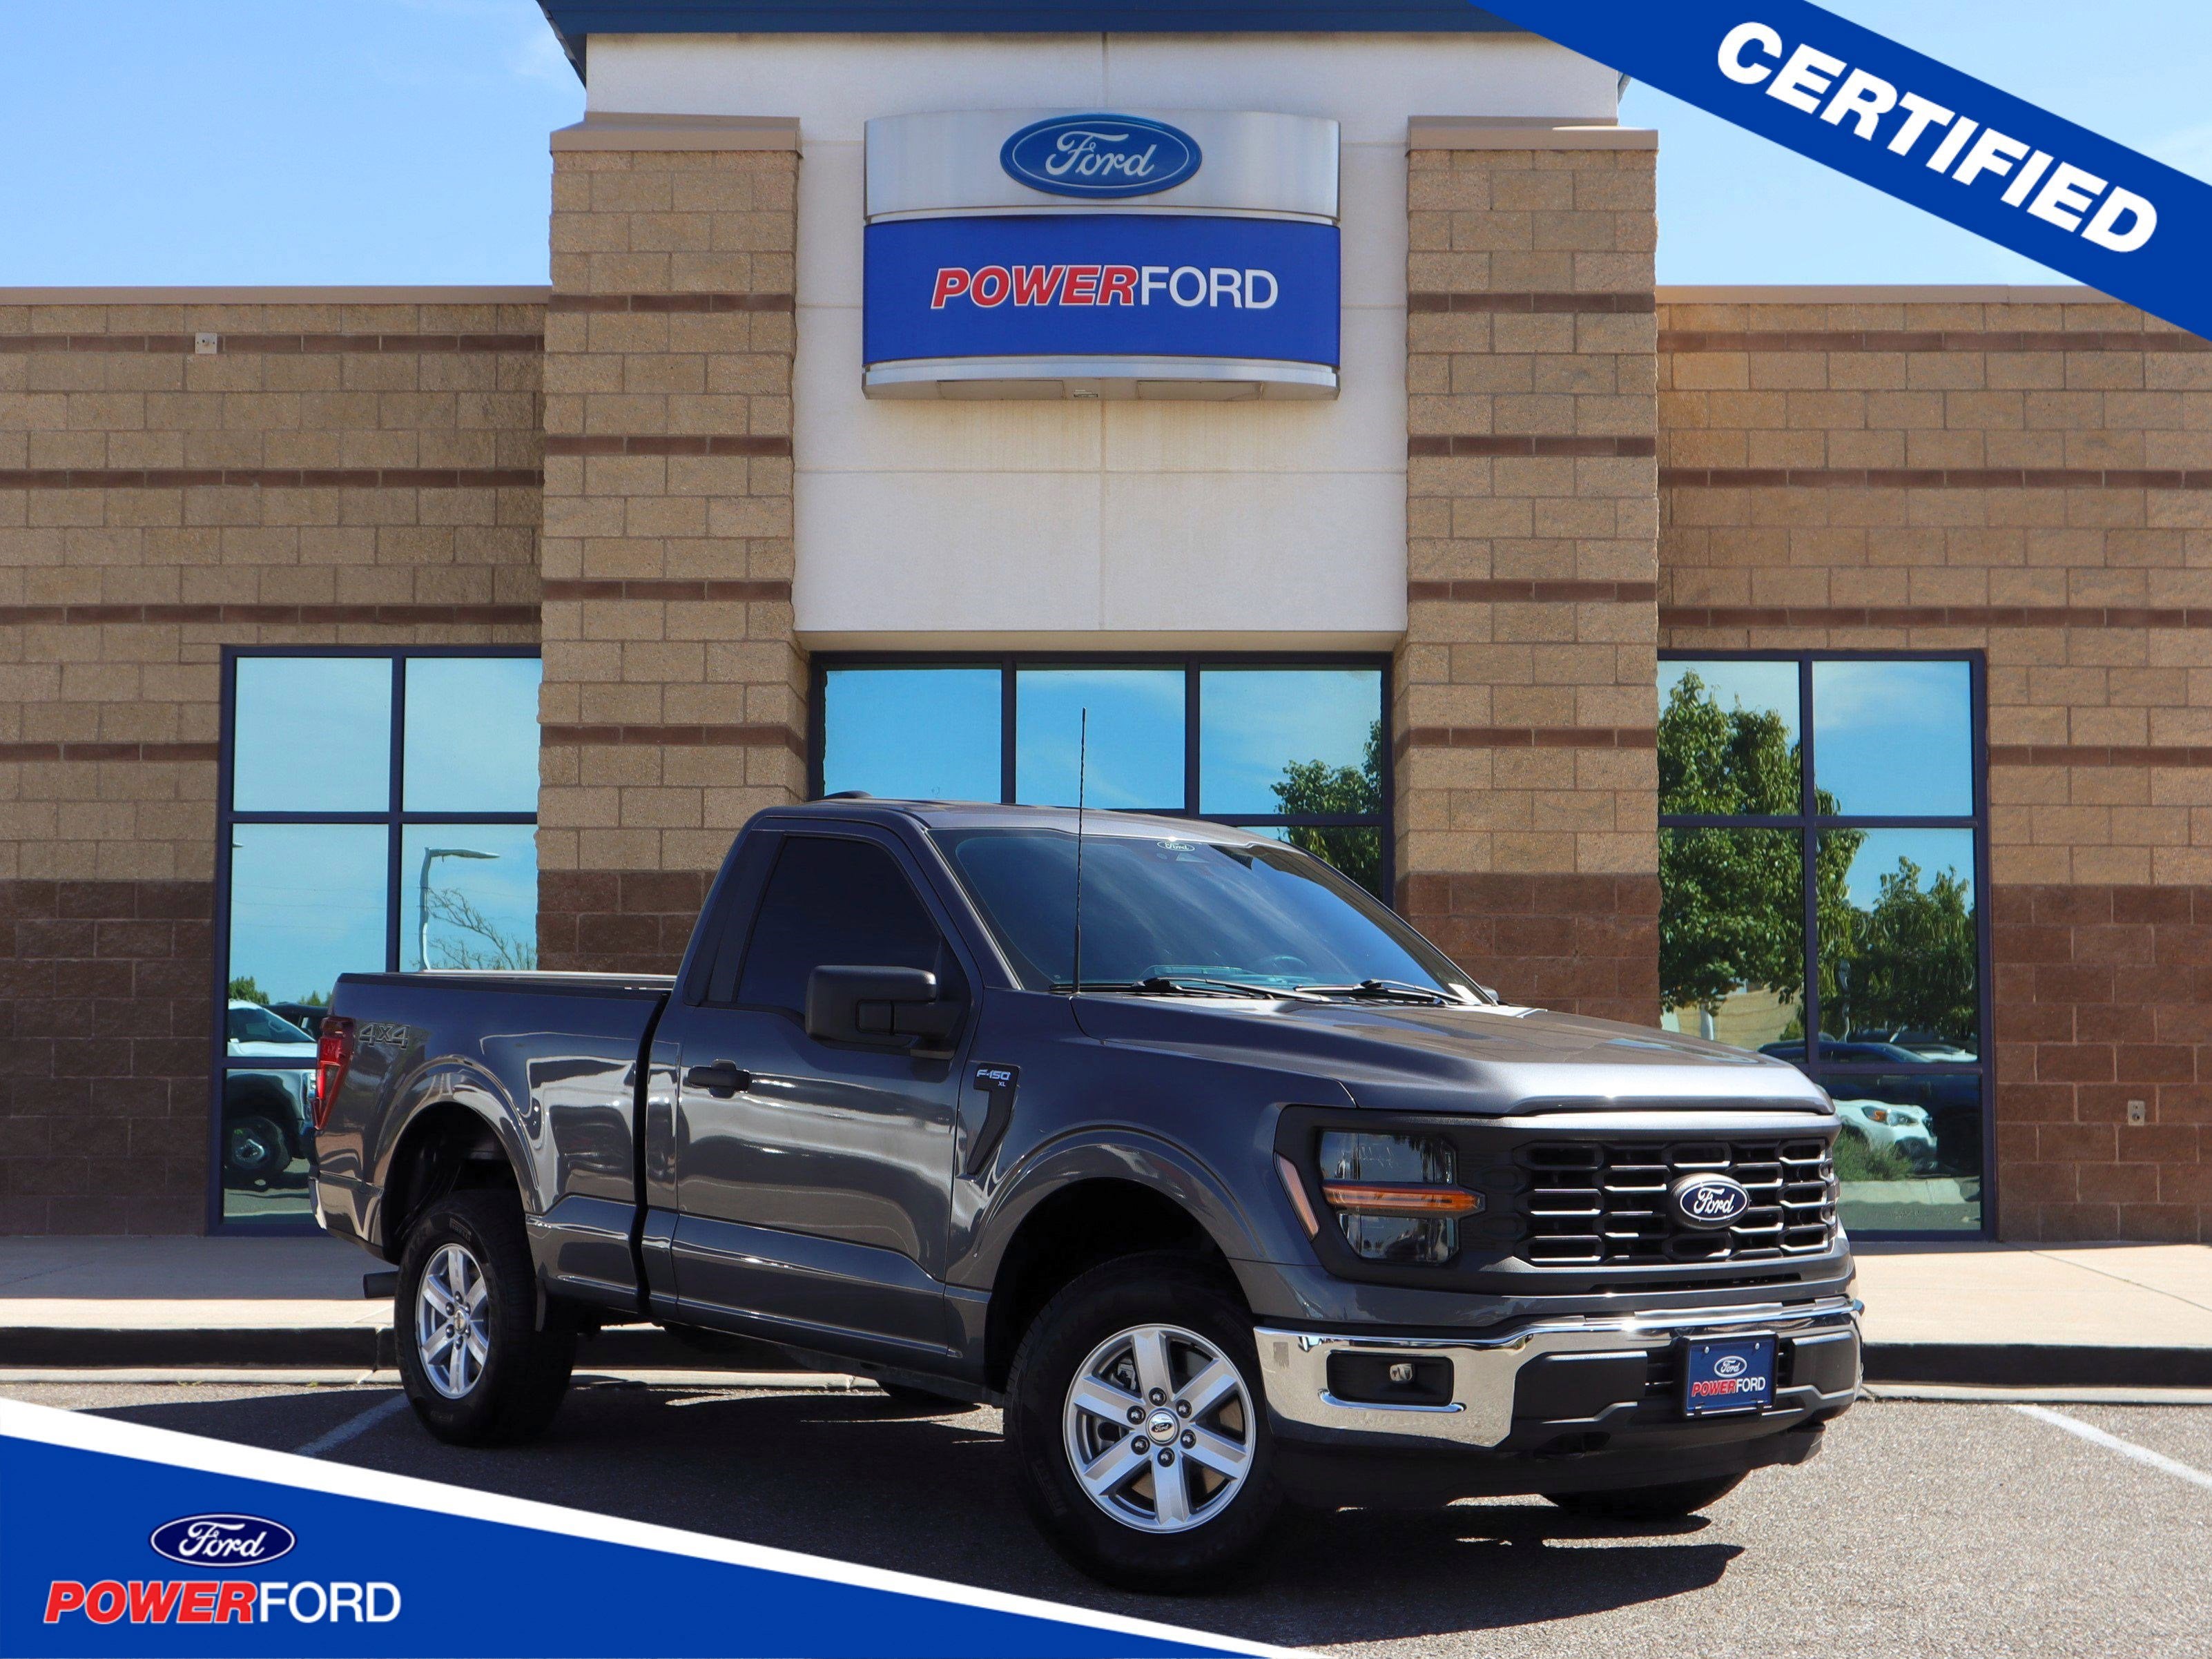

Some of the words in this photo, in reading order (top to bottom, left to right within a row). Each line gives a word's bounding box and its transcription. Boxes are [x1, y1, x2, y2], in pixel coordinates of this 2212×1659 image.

[1045, 130, 1155, 177] Ford
[930, 264, 1279, 309] POWERFORD
[1164, 842, 1190, 851] Ford
[976, 1069, 1011, 1081] F-150
[1693, 1187, 1736, 1214] Ford
[1720, 1359, 1741, 1373] Ford
[1691, 1376, 1766, 1397] POWERFORD
[1154, 1423, 1170, 1432] Ford
